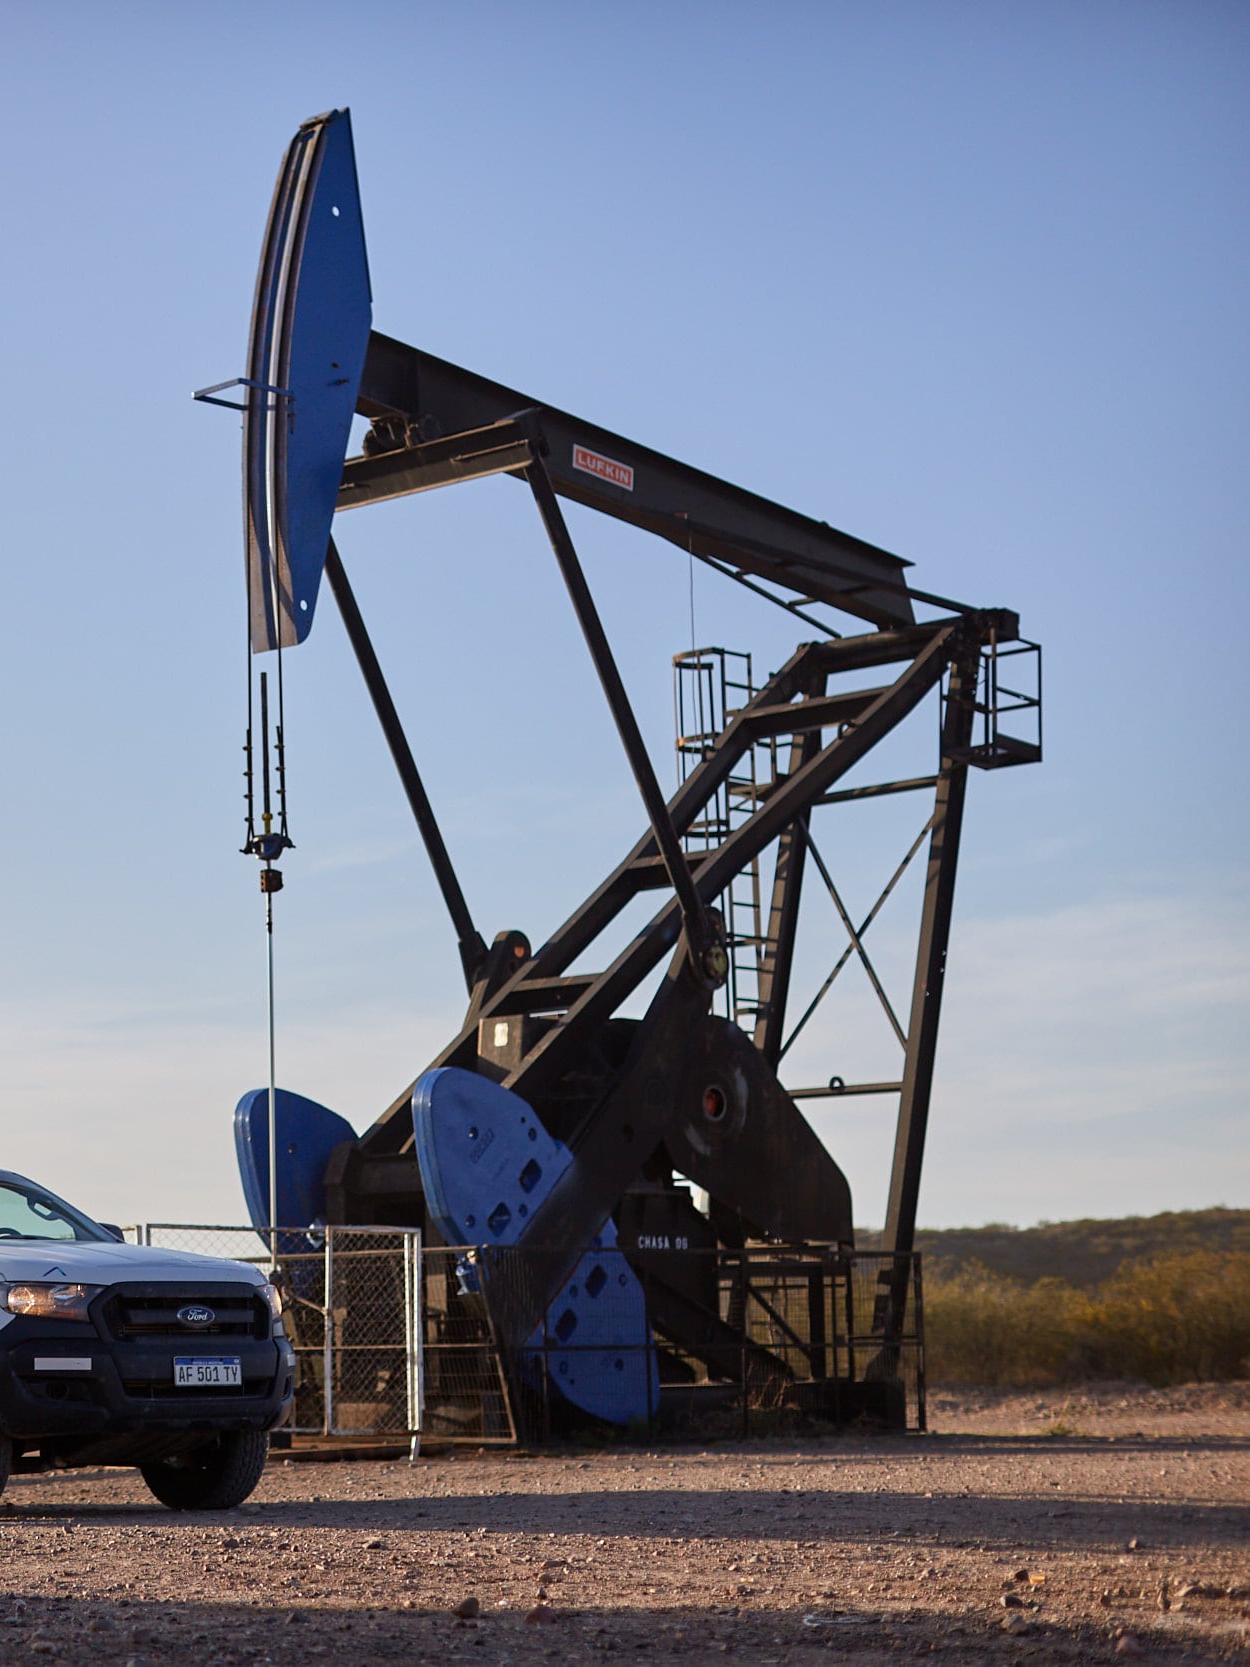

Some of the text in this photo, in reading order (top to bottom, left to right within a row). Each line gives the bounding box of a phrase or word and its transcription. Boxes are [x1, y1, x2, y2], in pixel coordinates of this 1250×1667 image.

[578, 452, 629, 483] LUFKIN
[638, 1235, 669, 1249] CHASA
[187, 1309, 207, 1320] Ford
[179, 1366, 238, 1382] AF 501 TY
